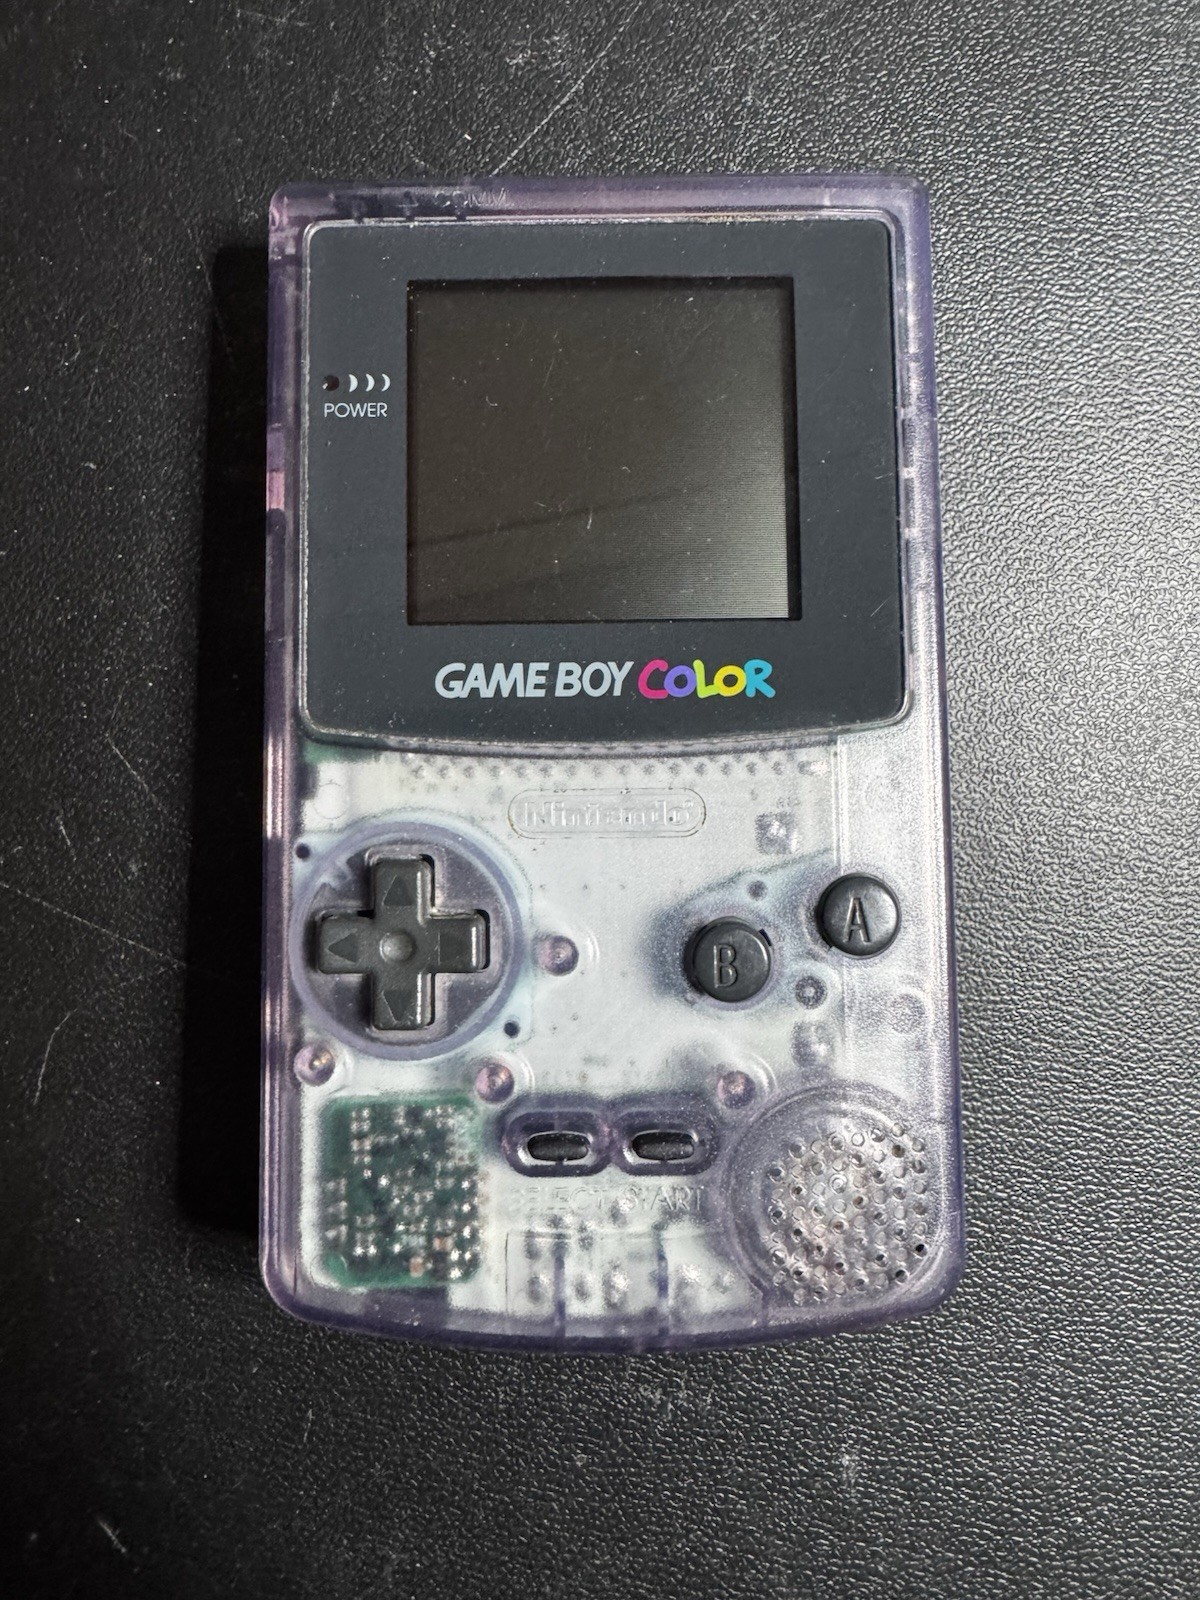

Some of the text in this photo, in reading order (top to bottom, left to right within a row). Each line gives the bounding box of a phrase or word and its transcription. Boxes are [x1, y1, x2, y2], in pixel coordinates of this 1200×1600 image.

[324, 402, 388, 418] POWER
[434, 659, 776, 699] GAME BOY COLOR
[522, 801, 690, 827] Nintendo
[843, 896, 871, 943] A
[713, 943, 739, 989] B
